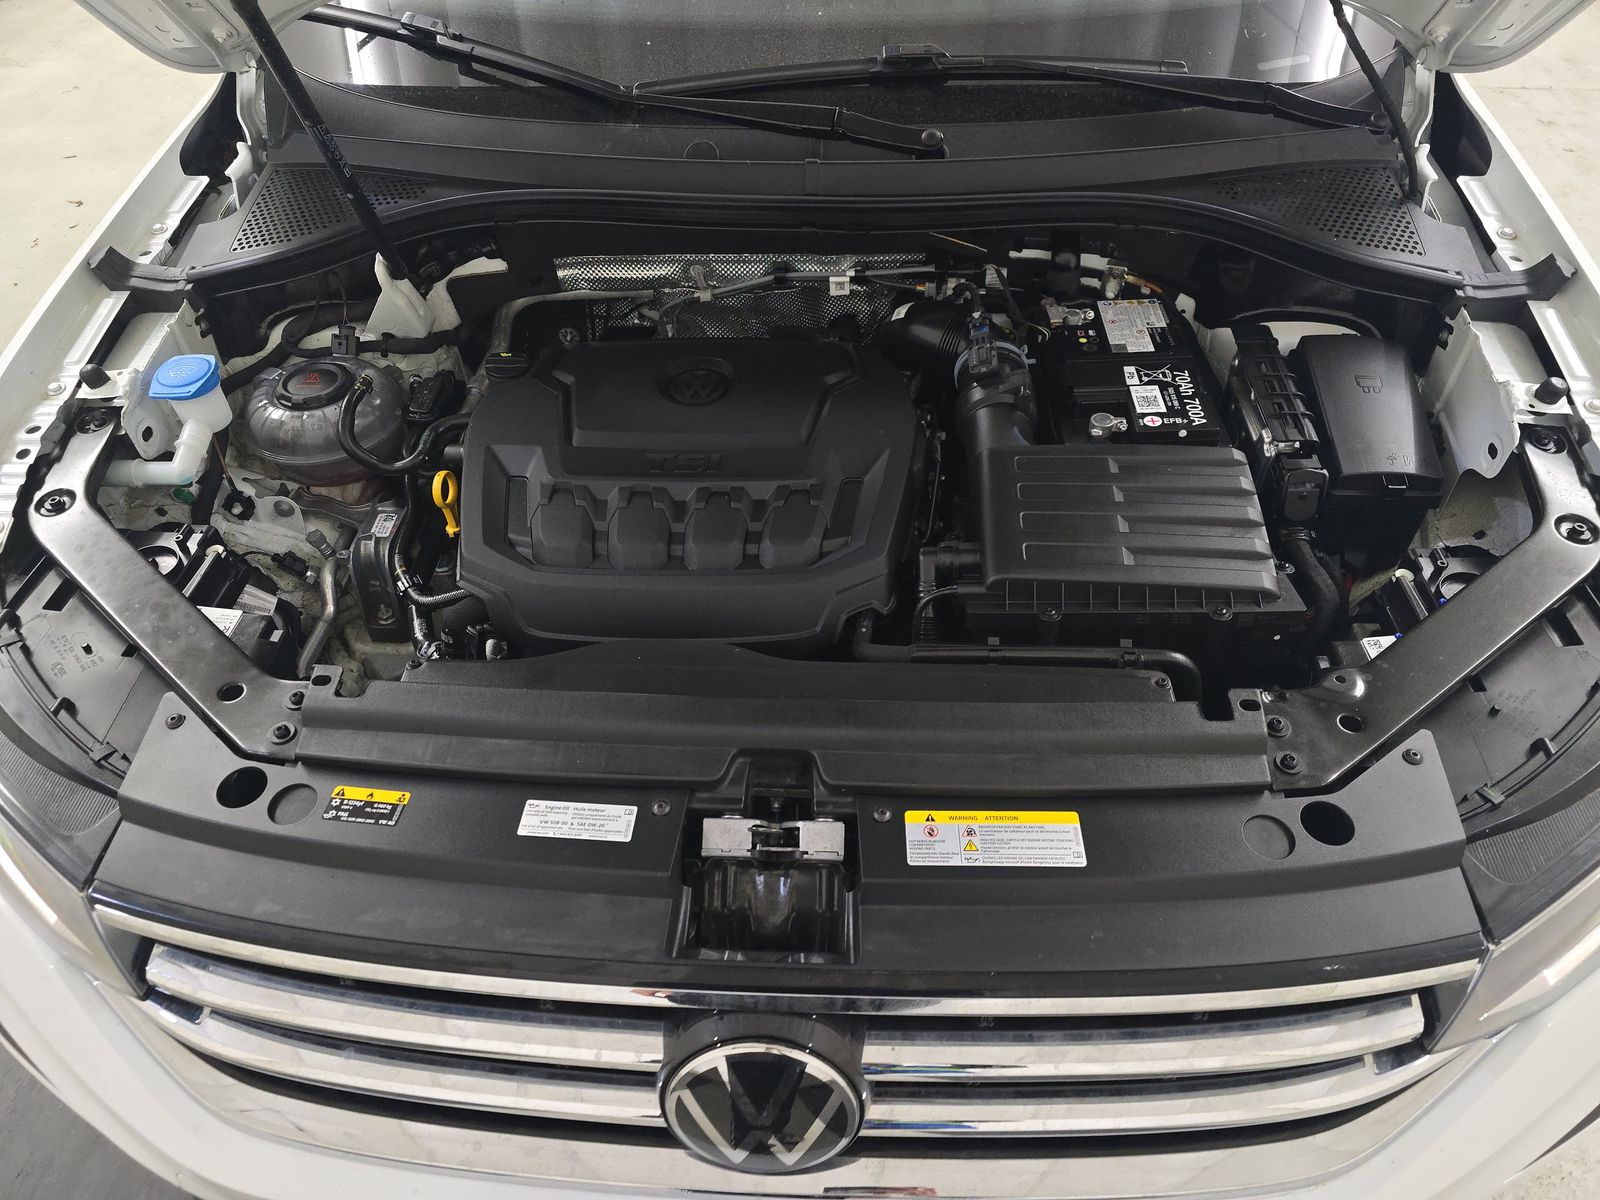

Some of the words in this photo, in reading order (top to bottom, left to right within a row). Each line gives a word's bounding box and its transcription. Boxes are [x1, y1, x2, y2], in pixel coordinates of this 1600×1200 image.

[1126, 371, 1135, 380] Pb
[1173, 370, 1196, 396] 70Ah
[1183, 397, 1208, 426] 700A
[645, 453, 722, 473] TSI
